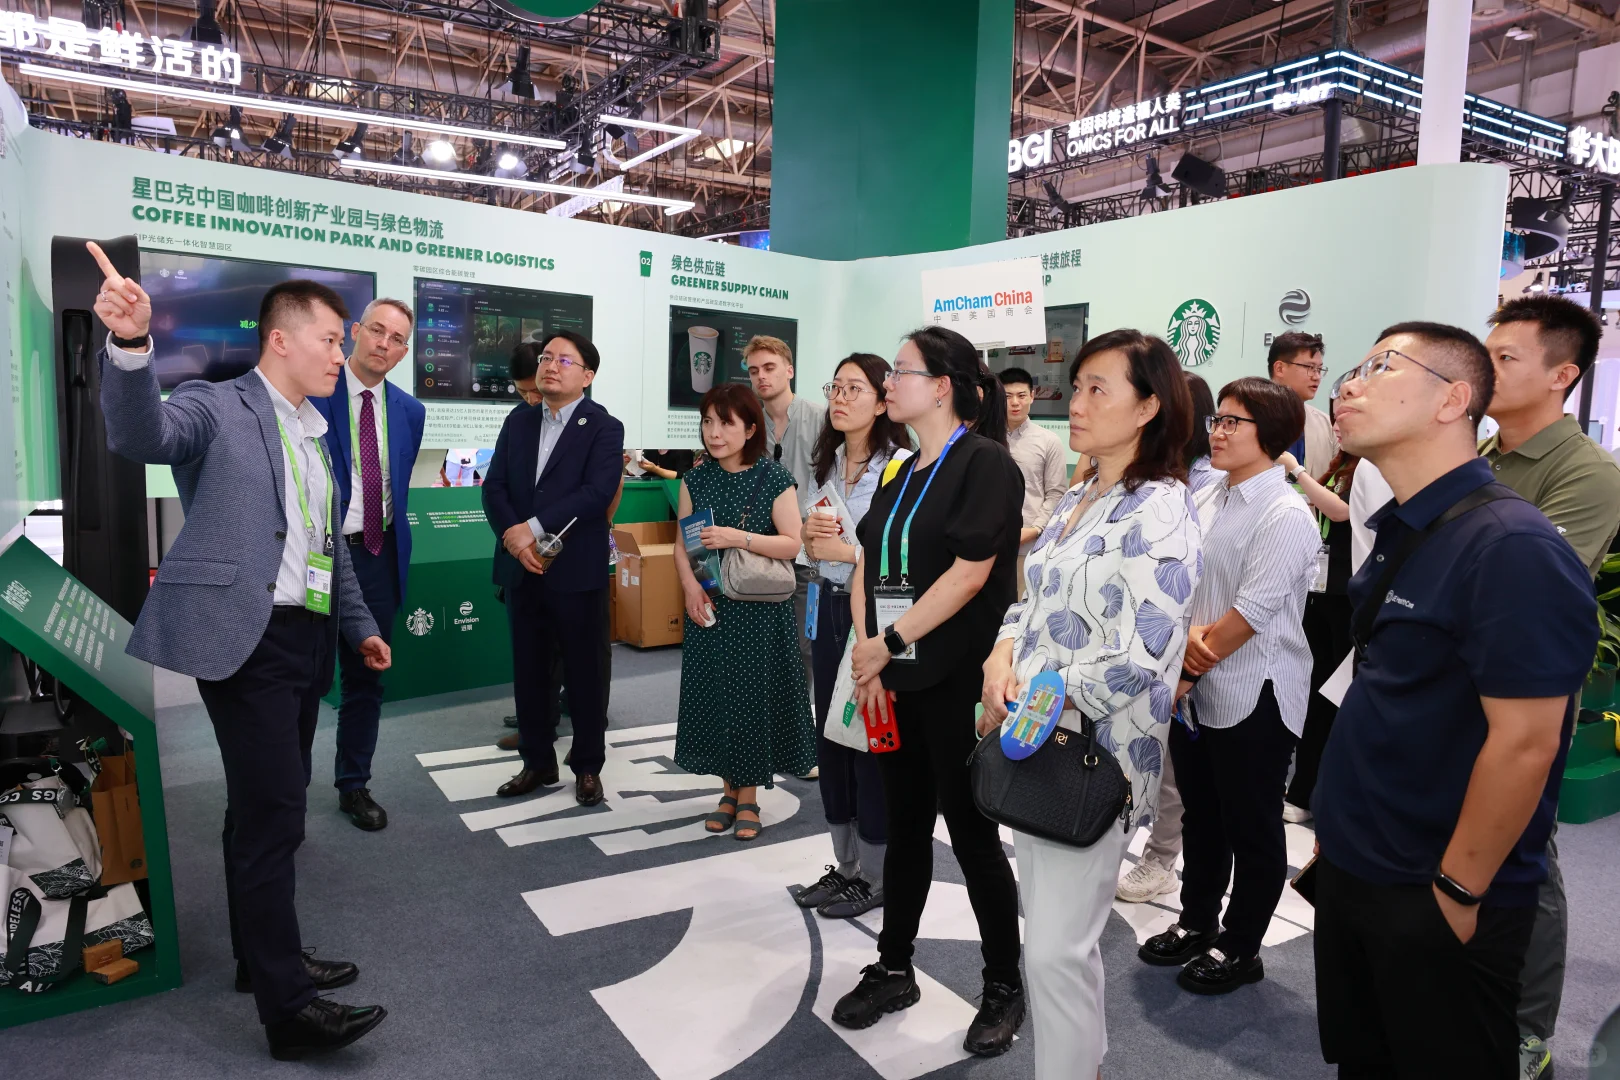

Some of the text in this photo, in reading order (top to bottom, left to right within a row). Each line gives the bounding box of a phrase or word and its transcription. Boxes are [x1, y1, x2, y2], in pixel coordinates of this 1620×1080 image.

[1068, 91, 1182, 139] 基因科技造福人类
[1066, 115, 1180, 158] OMICS FOR ALL
[1008, 129, 1053, 173] BGI
[131, 176, 445, 239] 星巴克中国咖啡创新产业园与绿色物流
[132, 204, 555, 271] COFFEE INNOVATION PARK AND GREENER LOGISTICS
[132, 232, 232, 252] IP光储充一体化智慧园区
[640, 257, 651, 266] 02
[671, 254, 726, 278] 绿色供应链
[671, 274, 789, 301] GREENER SUPPLY CHAIN
[933, 289, 1033, 313] AmCham China
[933, 305, 1033, 324] 中国美国商会
